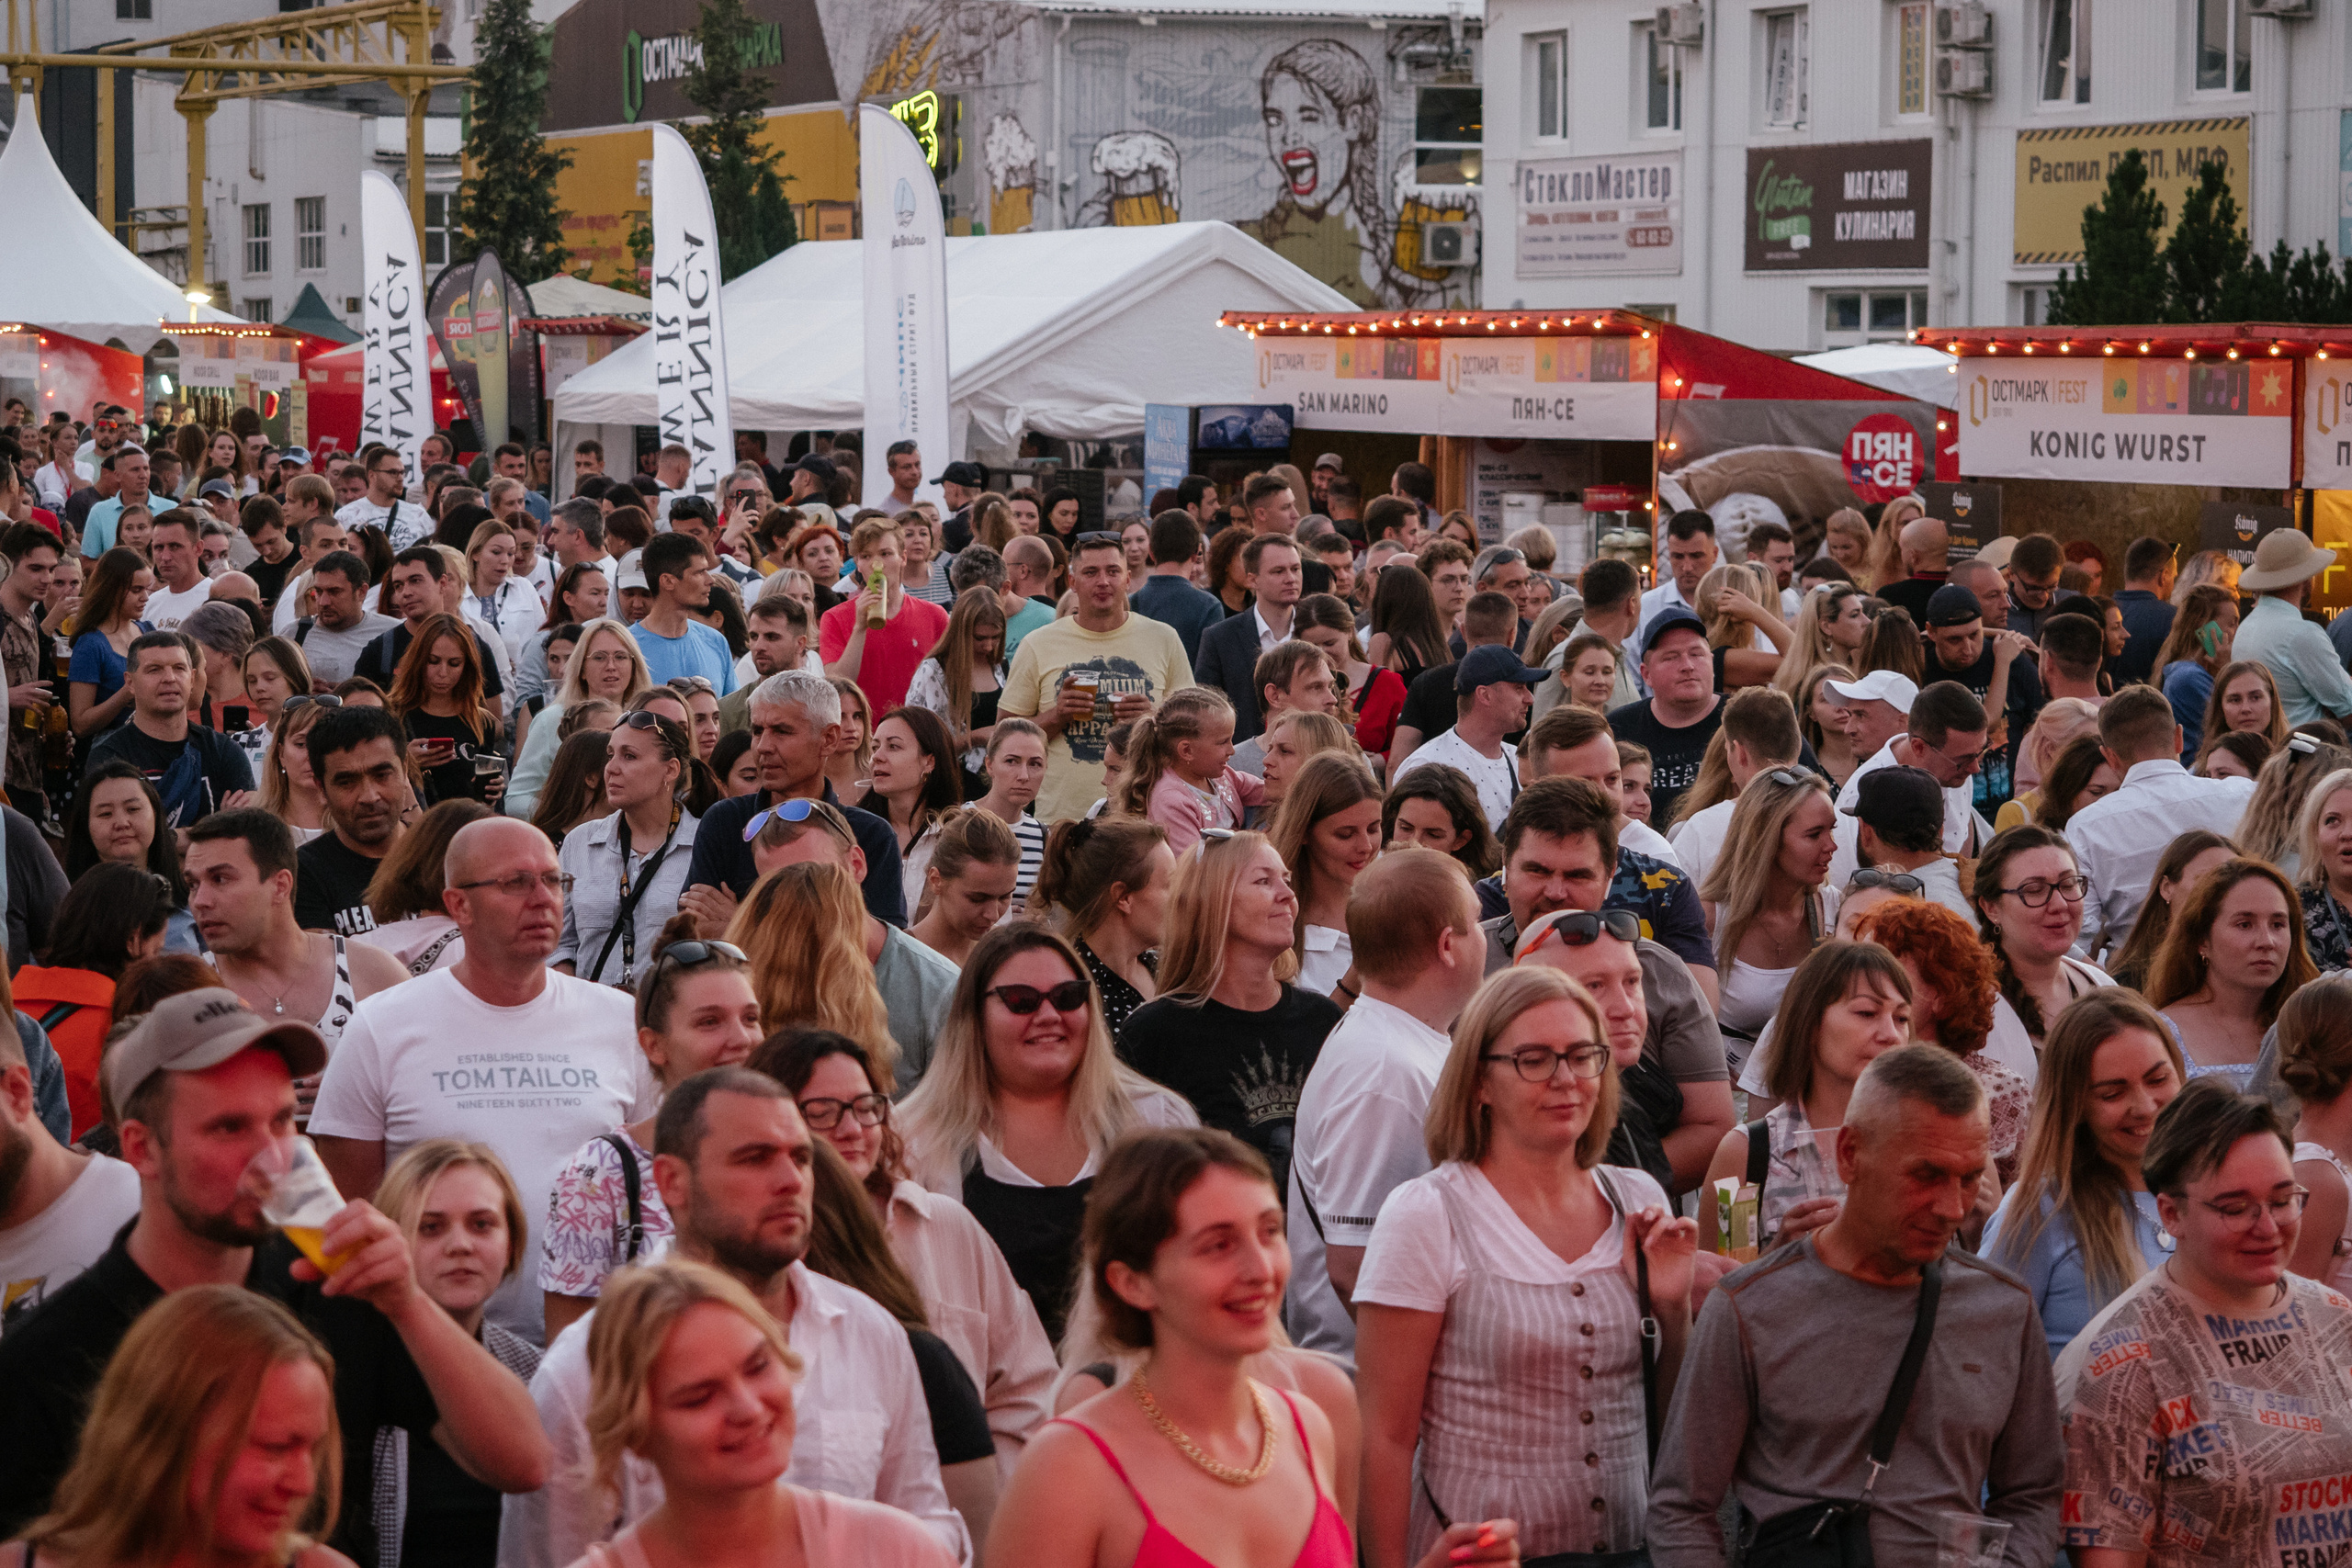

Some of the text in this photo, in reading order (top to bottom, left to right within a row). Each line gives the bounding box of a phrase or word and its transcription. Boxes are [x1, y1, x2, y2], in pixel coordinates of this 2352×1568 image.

[2029, 154, 2101, 184] Распил
[1843, 168, 1909, 201] МАГАЗИН
[1834, 209, 1917, 242] КУЛИНАРИЯ
[908, 292, 917, 315] ФУД
[909, 322, 917, 355] СТРИТ
[1462, 355, 1499, 376] ОСТМАРК
[1298, 391, 1388, 415] SAN MARINO
[1991, 378, 2087, 404] ОСТМАРК FEST
[1512, 397, 1575, 421] ПЯН-СЕ
[1852, 432, 1913, 460] ПЯН
[2030, 430, 2207, 463] KONIG WURST
[1872, 460, 1913, 487] СЕ
[1099, 678, 1147, 694] MIUM
[1068, 720, 1110, 736] APPA
[1653, 761, 1702, 788] REAT
[334, 905, 378, 935] PLEA
[457, 1053, 571, 1065] ESTABLISHED SINCE
[433, 1066, 600, 1091] TOM TAILOR
[457, 1098, 582, 1110] NINETEEN SIXTY TWO
[2088, 1327, 2143, 1358] TIMES
[2304, 1340, 2317, 1361] only
[2310, 1364, 2324, 1382] get
[2265, 1392, 2317, 1416] TIMES
[2318, 1382, 2333, 1412] better
[2151, 1395, 2199, 1436] OCK
[2257, 1408, 2323, 1433] BETTER
[2226, 1459, 2238, 1483] only
[2224, 1485, 2237, 1505] get
